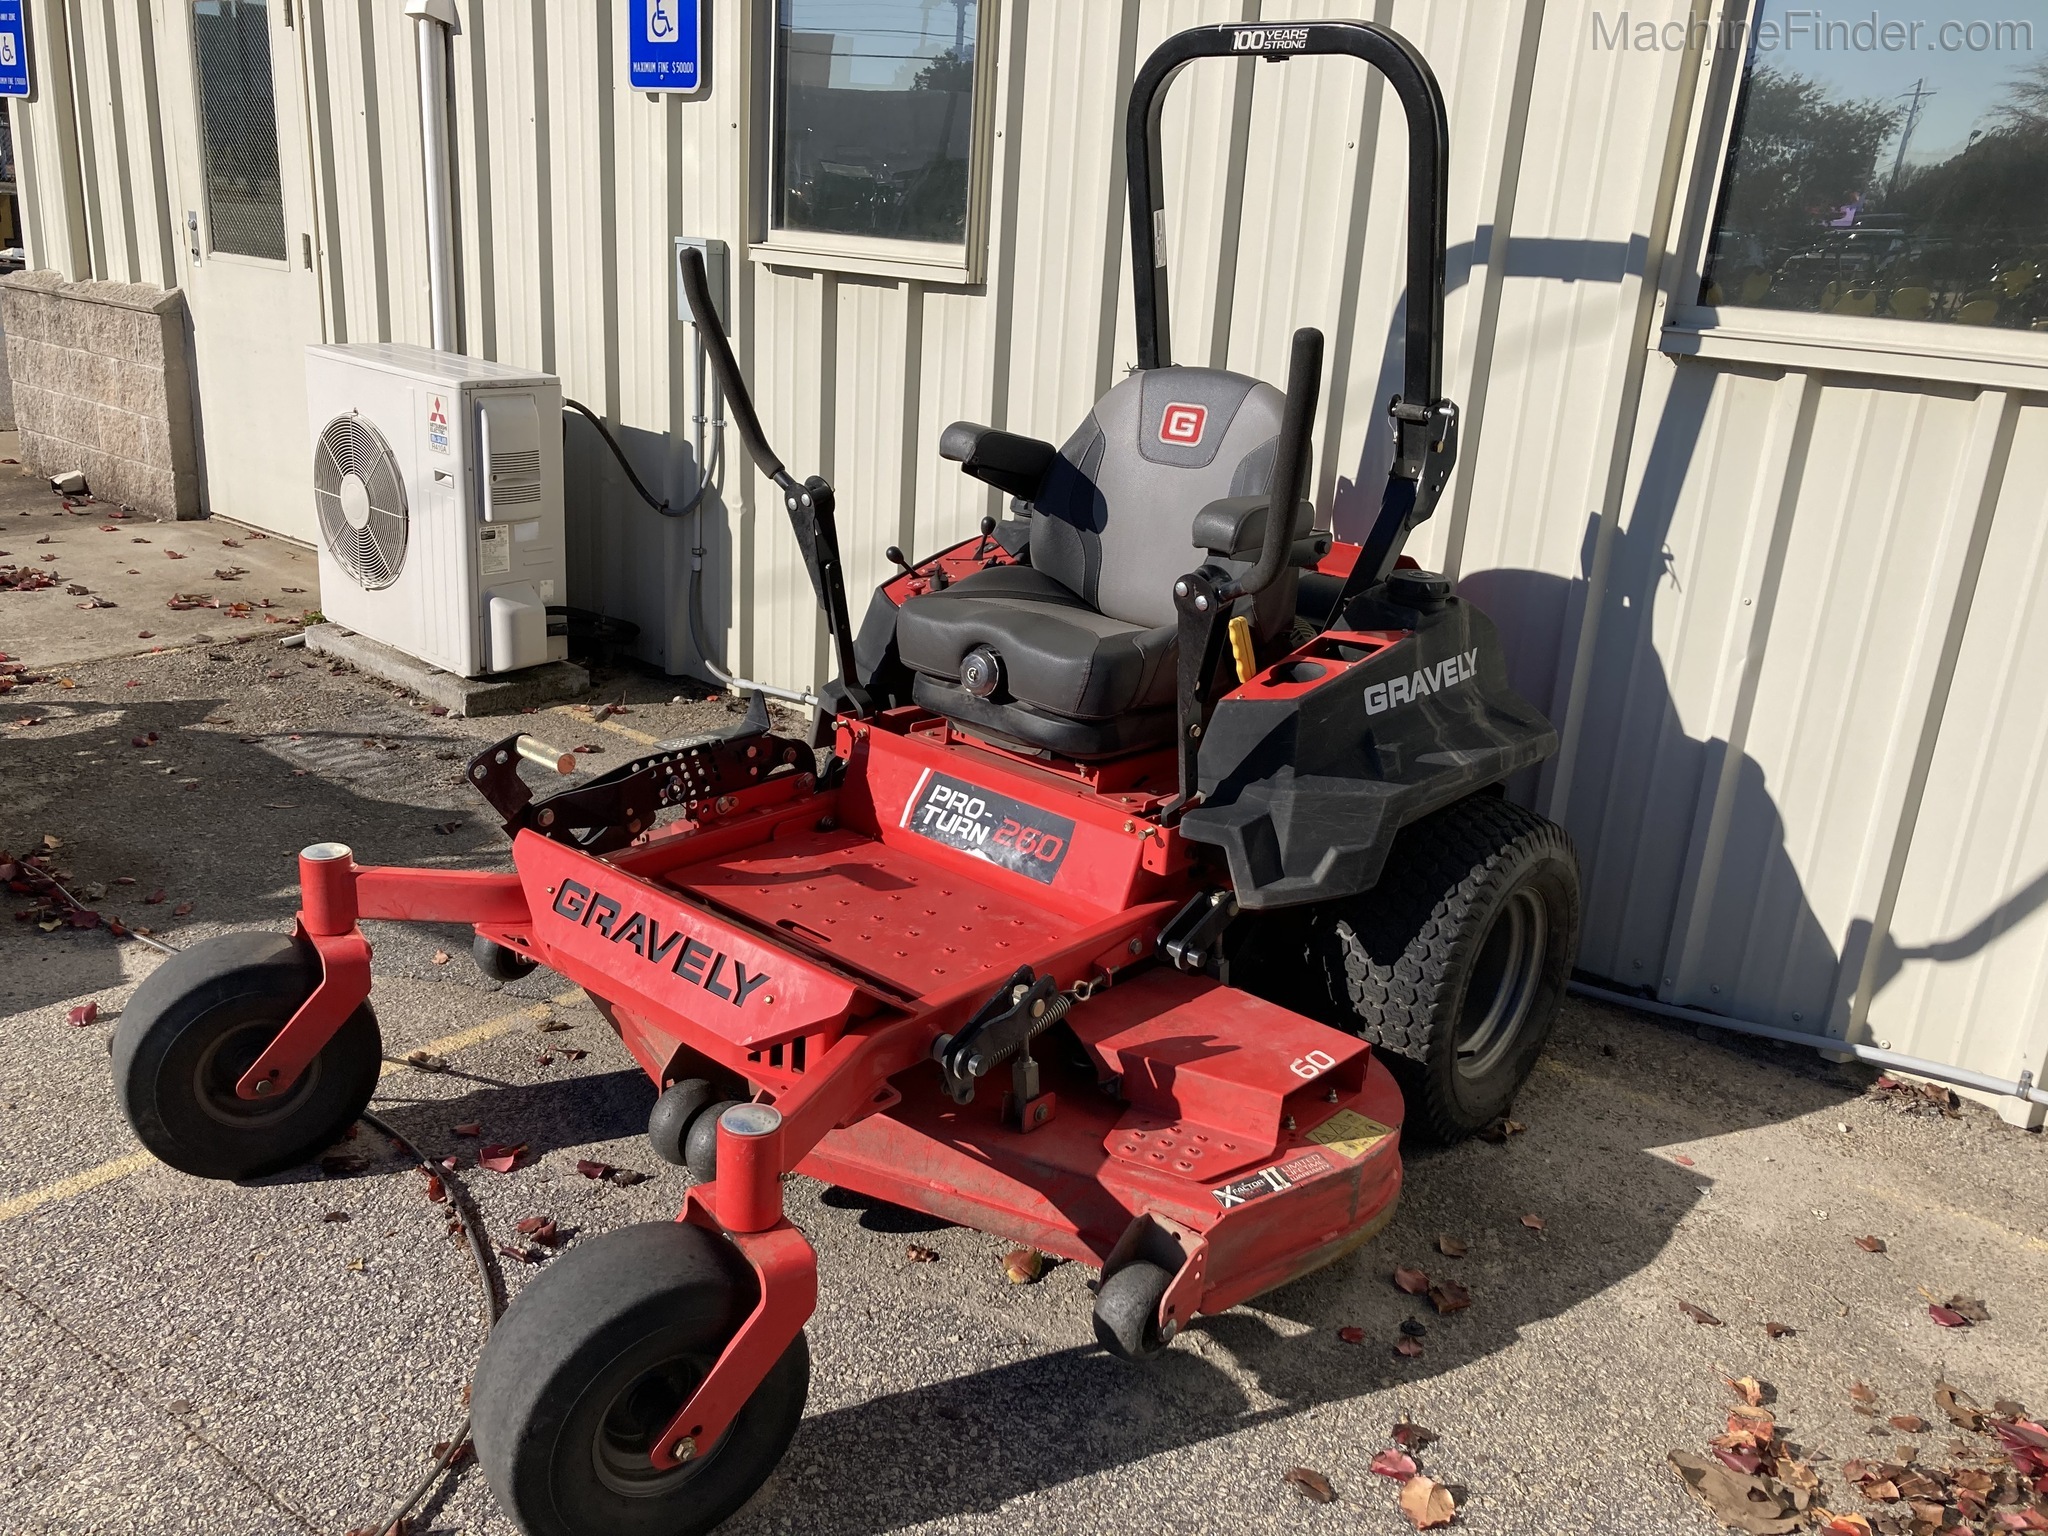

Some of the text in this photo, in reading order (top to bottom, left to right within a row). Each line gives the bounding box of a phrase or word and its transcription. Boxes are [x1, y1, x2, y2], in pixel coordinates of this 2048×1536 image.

[1233, 28, 1309, 50] 100 YEARS
[1264, 40, 1306, 49] STRONG
[633, 62, 657, 73] MAXIMUM
[658, 62, 669, 73] FINE
[1168, 410, 1198, 437] G
[1364, 647, 1478, 716] GRAVELY
[928, 784, 993, 819] PRO-
[923, 804, 1063, 863] TURN 260
[552, 878, 771, 1008] GRAVELY
[1290, 1050, 1336, 1079] 60
[1280, 1154, 1320, 1173] LIMITED
[1232, 1179, 1265, 1196] FACTOR
